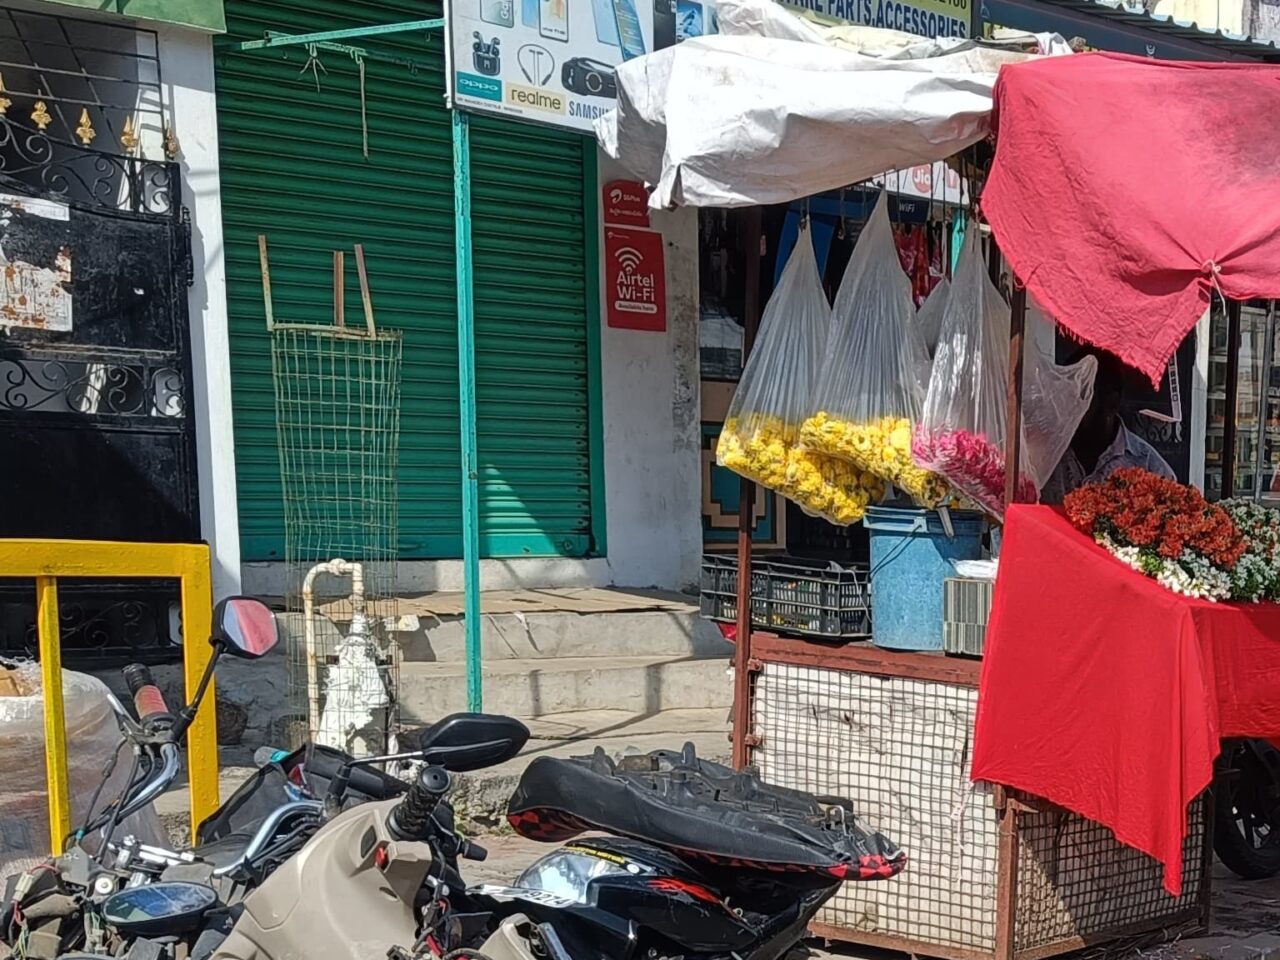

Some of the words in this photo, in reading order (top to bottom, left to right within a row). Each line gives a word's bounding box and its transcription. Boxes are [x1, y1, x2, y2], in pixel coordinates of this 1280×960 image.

[511, 89, 561, 110] realme
[616, 271, 654, 287] Airtel
[617, 285, 655, 301] Wi-Fi
